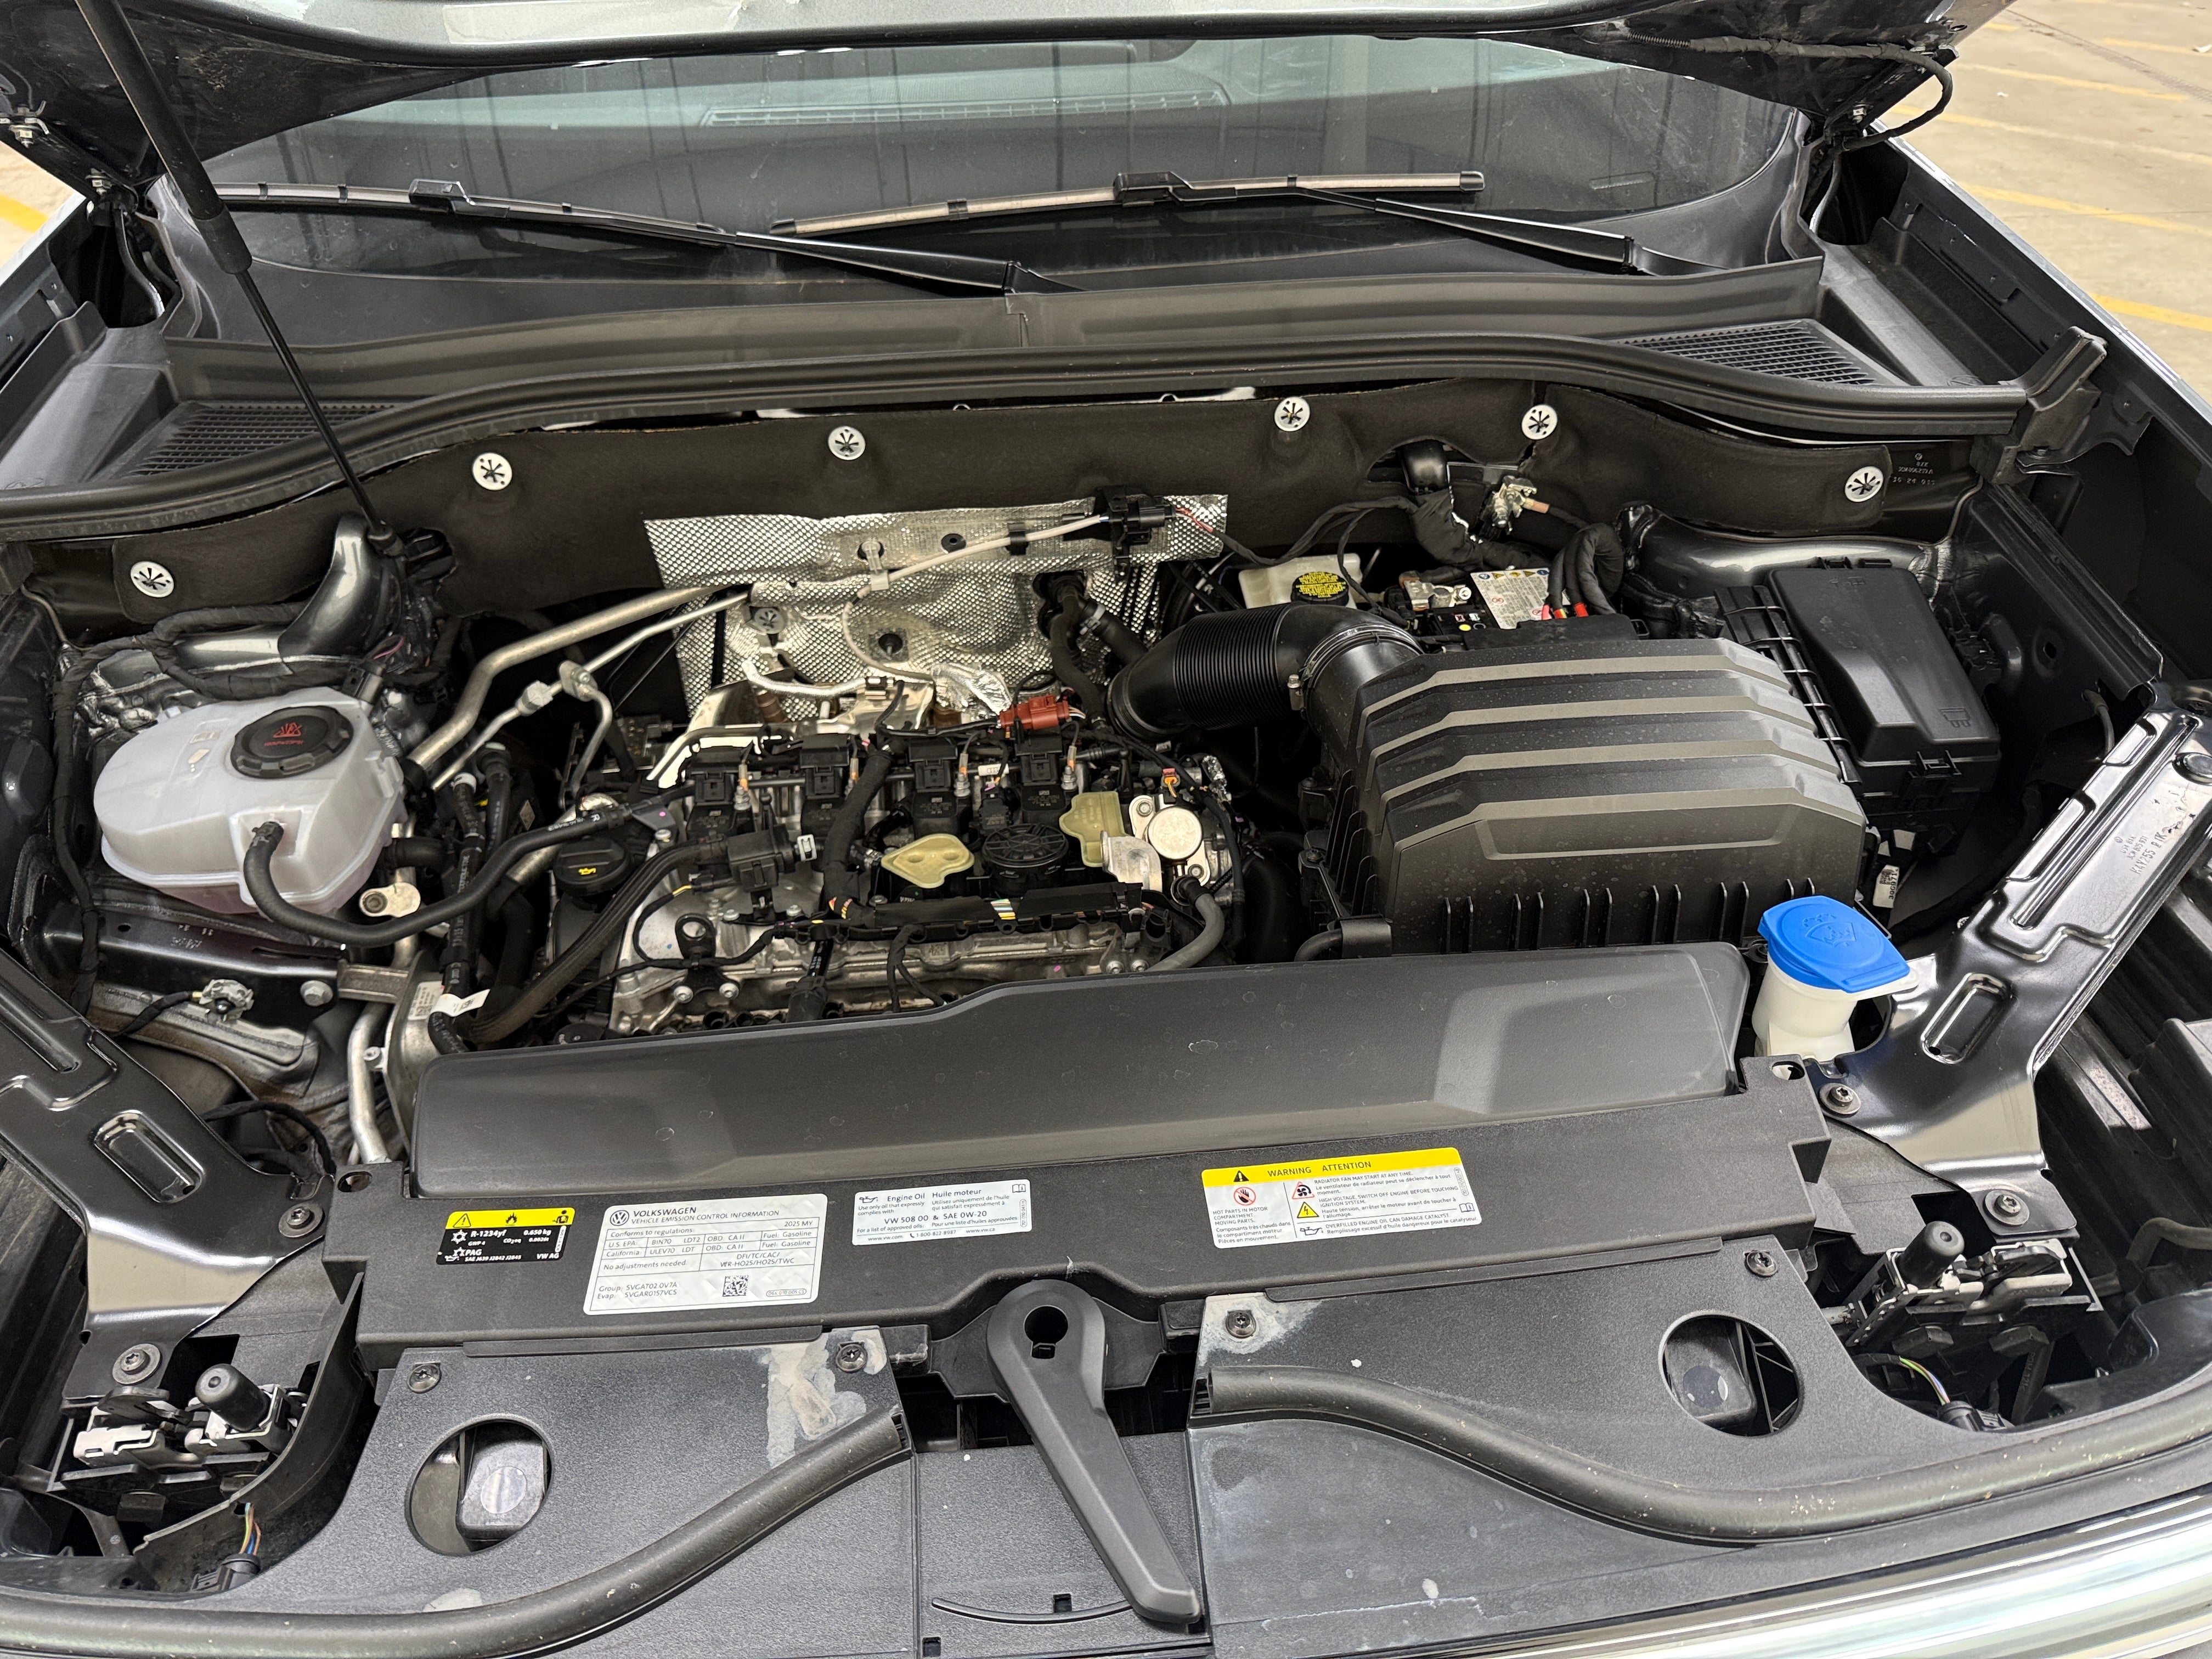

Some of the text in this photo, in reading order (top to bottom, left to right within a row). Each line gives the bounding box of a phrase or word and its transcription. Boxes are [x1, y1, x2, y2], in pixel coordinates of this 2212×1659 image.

[1267, 1161, 1372, 1177] WARNING ATTENTION
[634, 1207, 696, 1216] VOLKSWAGEN
[471, 1229, 507, 1238] R-1234yf
